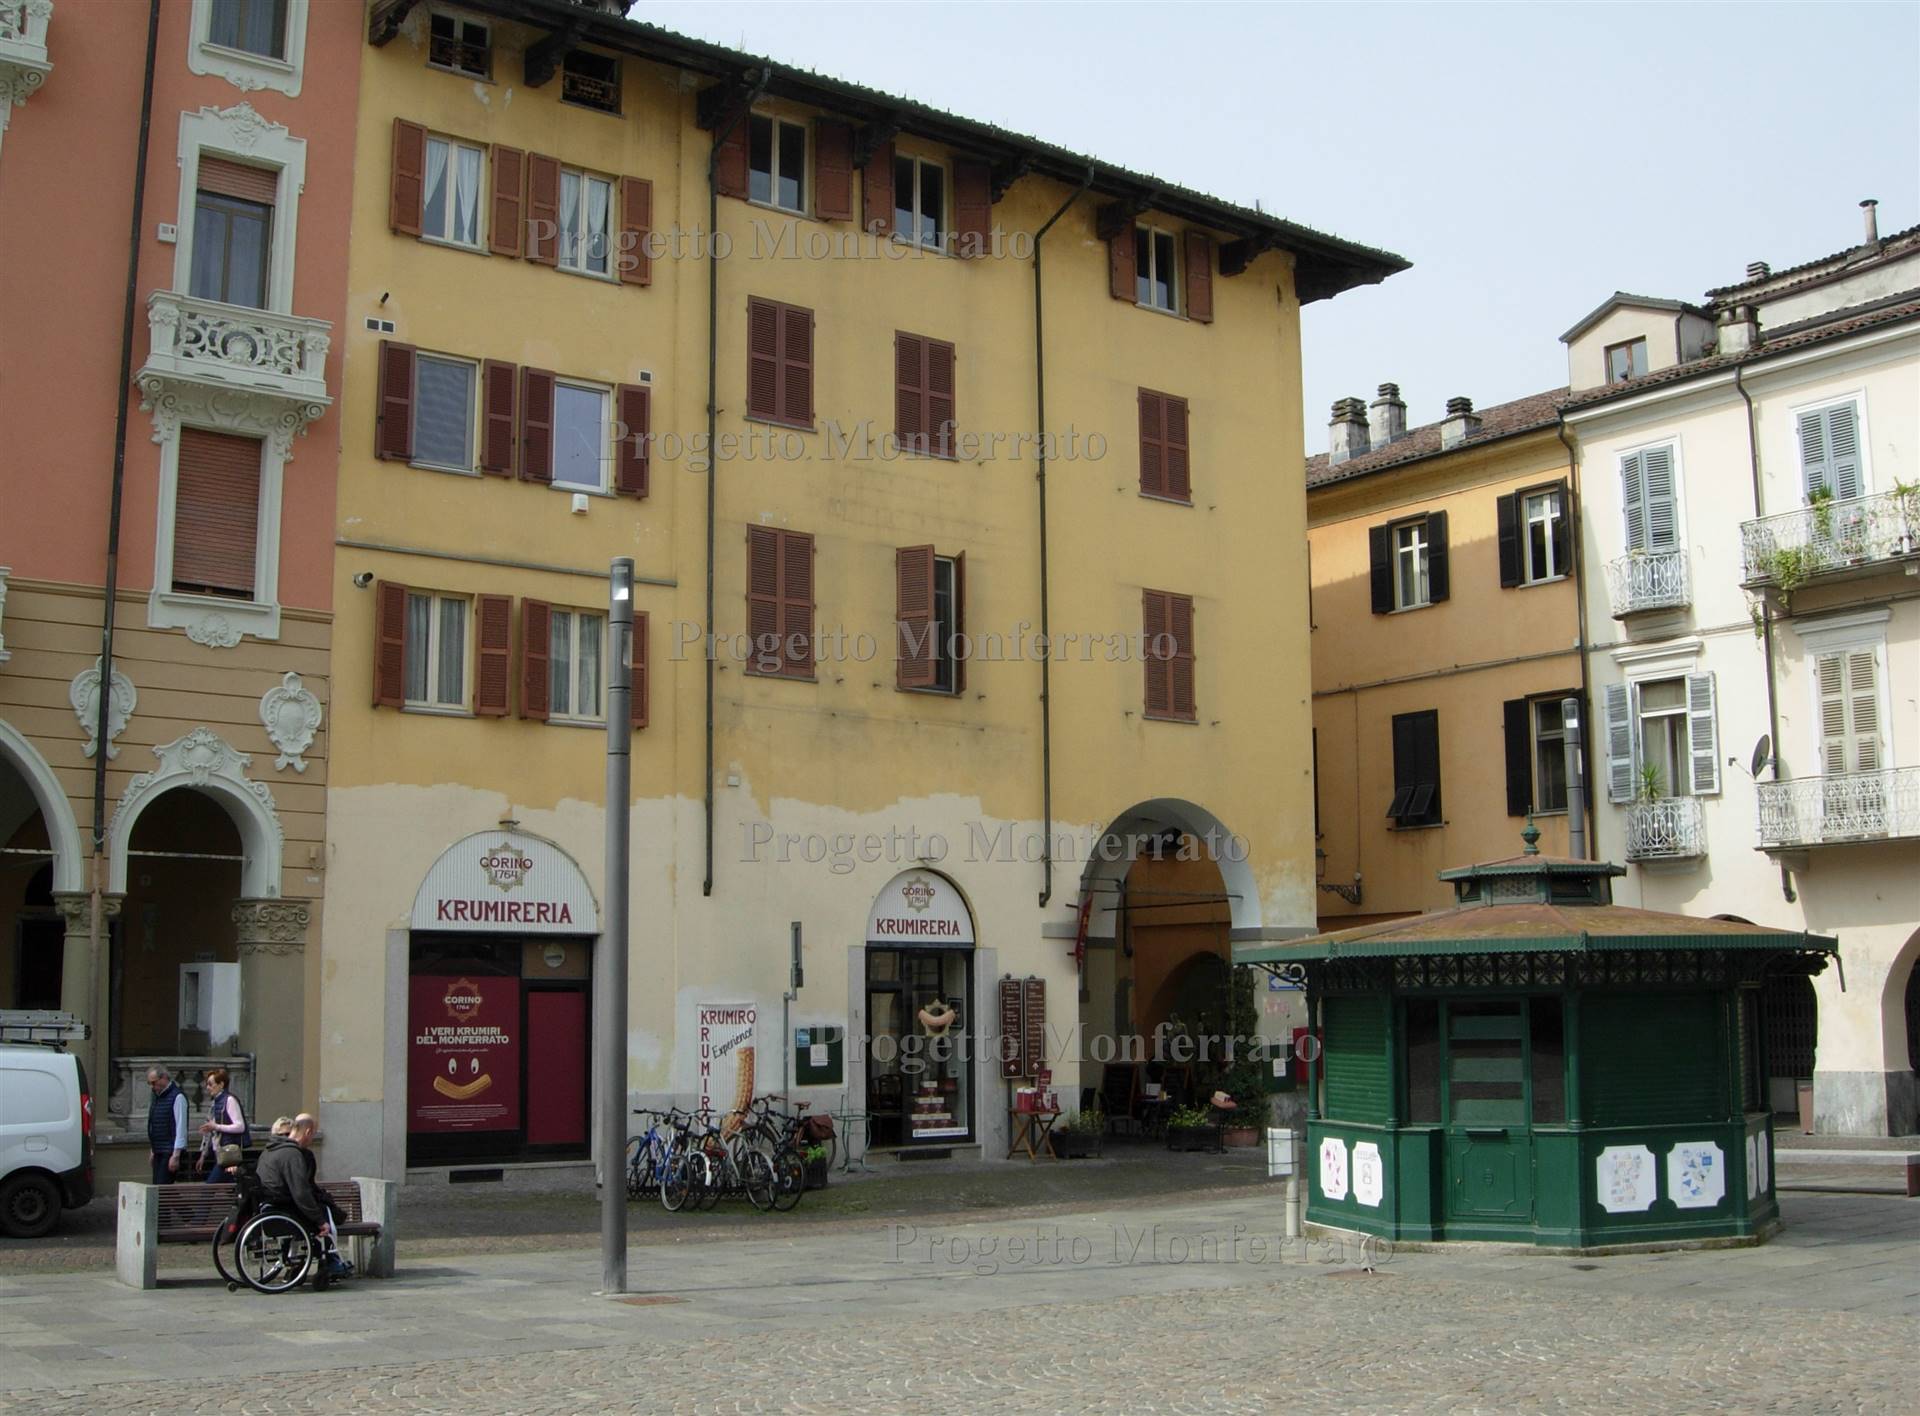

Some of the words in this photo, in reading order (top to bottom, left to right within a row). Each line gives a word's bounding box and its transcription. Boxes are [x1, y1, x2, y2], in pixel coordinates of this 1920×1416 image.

[480, 857, 533, 870] CORINO
[494, 870, 518, 880] 1764
[437, 899, 573, 924] KRUMIRERIA
[876, 918, 961, 936] KRUMIRERIA
[444, 996, 481, 1004] CORINO
[701, 1010, 756, 1025] KRUMIRO
[431, 1026, 455, 1035] VERI
[457, 1026, 500, 1035] KRUMIRI
[416, 1036, 437, 1045] DEL
[438, 1035, 509, 1044] MONFERRATO
[712, 1026, 753, 1059] Experience
